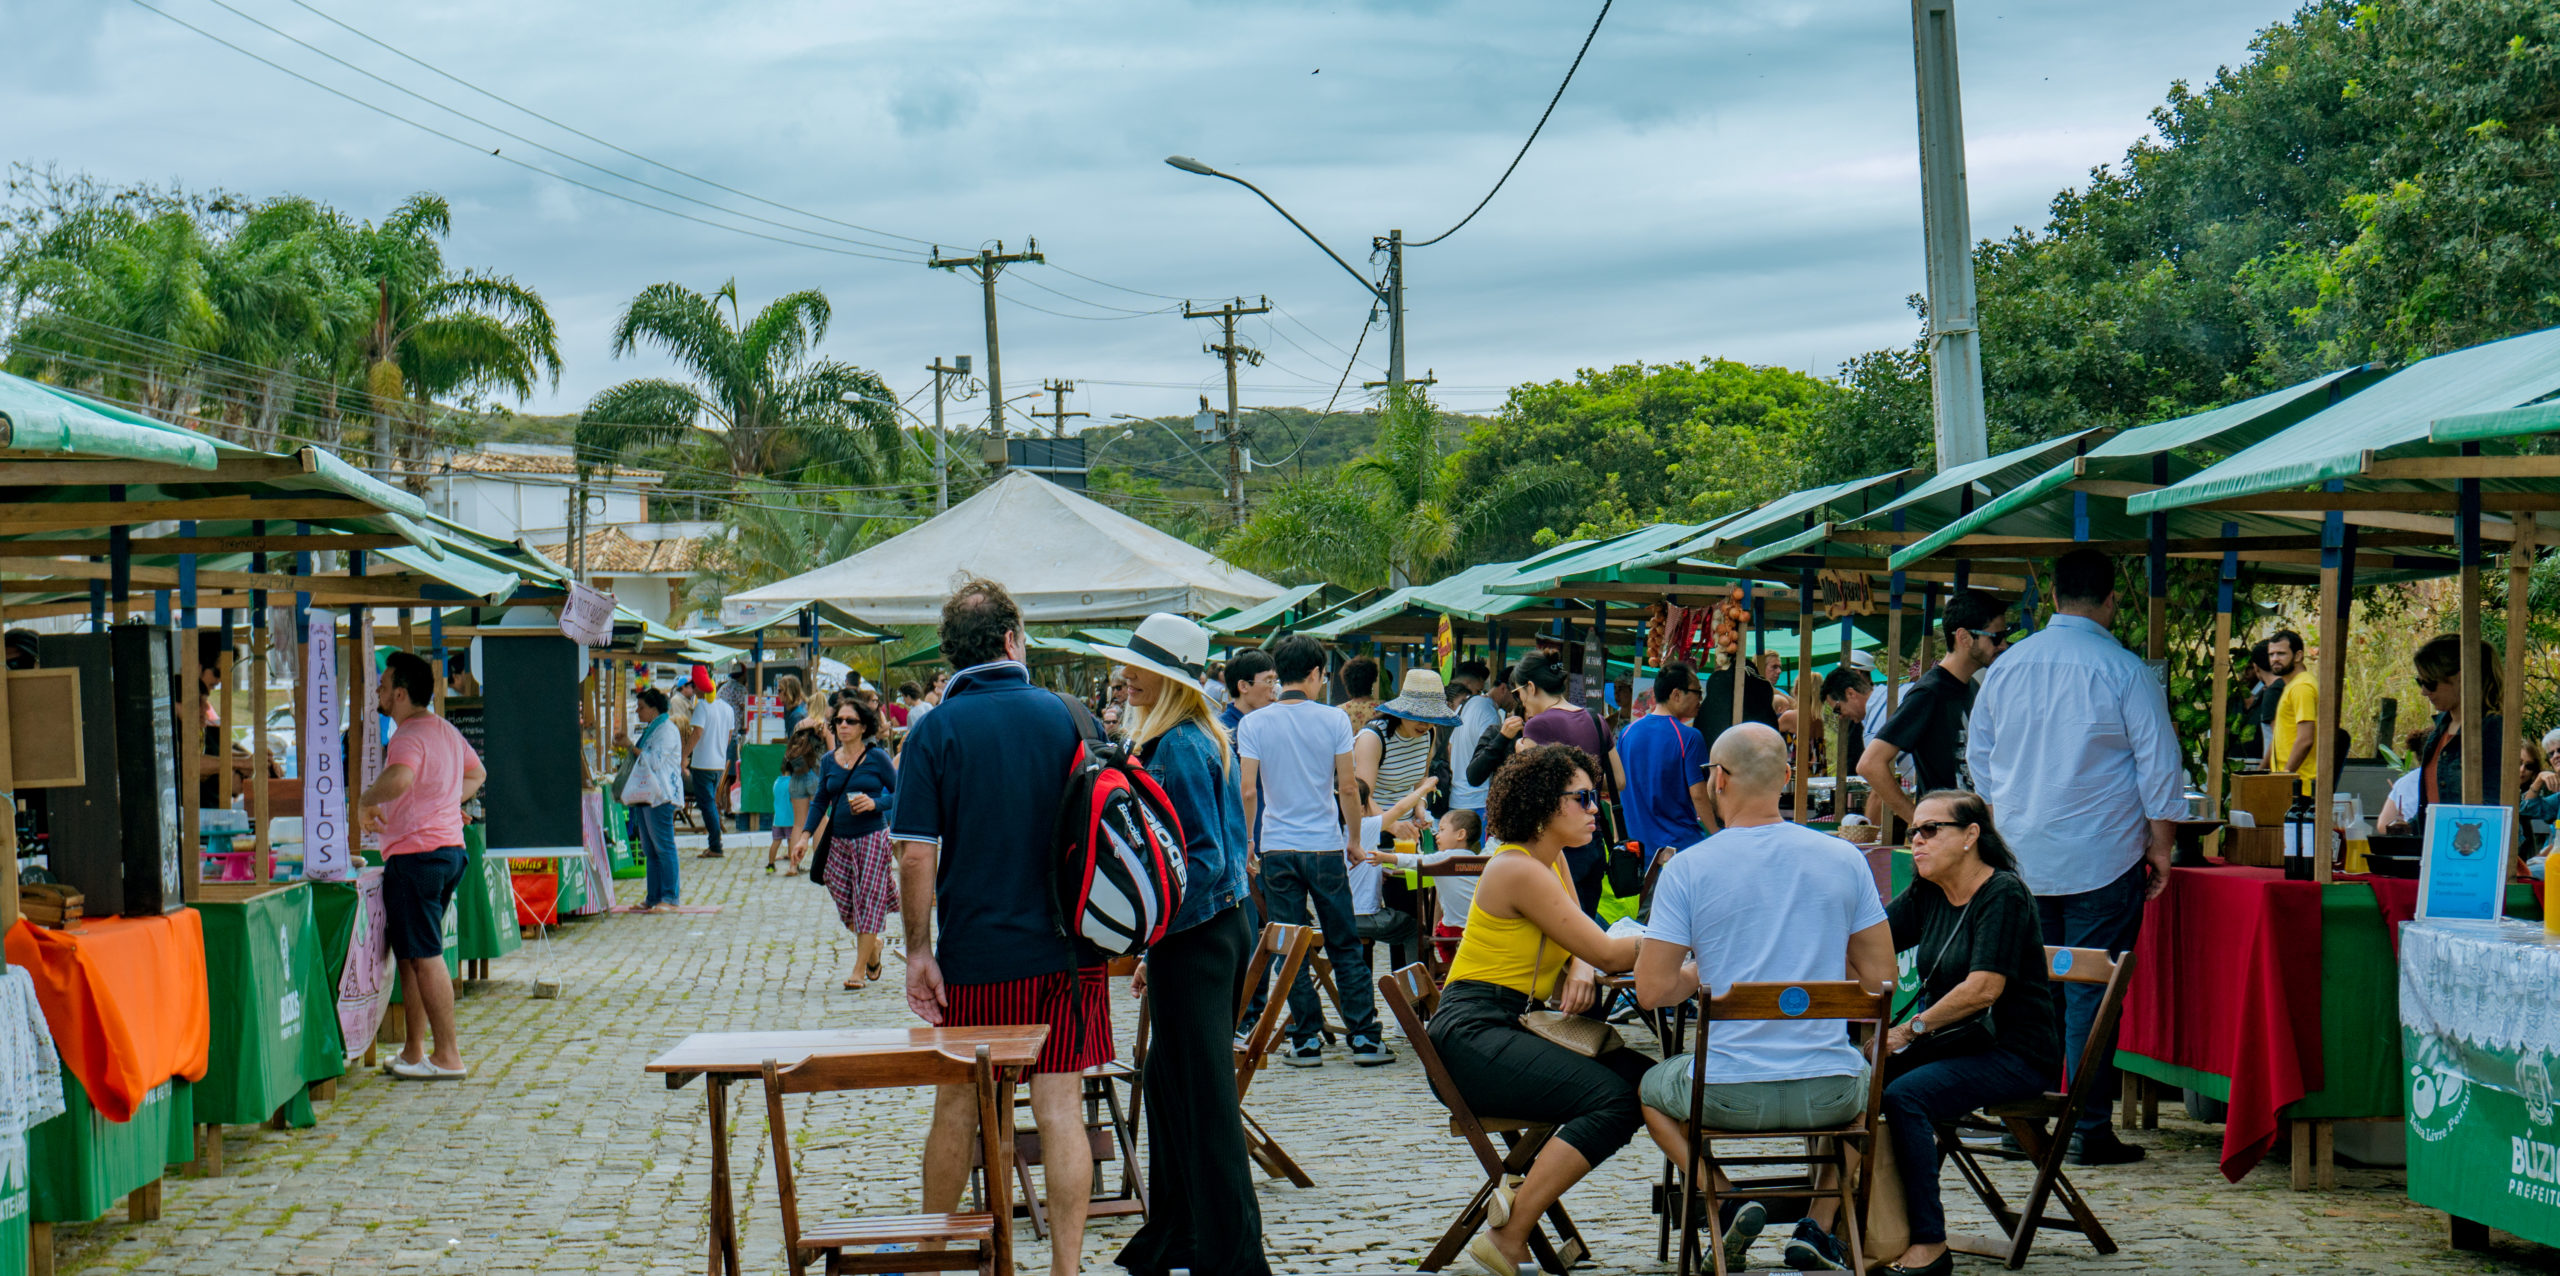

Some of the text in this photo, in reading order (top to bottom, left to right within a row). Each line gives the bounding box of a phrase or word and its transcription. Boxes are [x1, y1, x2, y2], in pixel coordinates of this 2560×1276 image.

[316, 639, 335, 863] PÃES BOLOS
[2426, 1127, 2448, 1142] Livre
